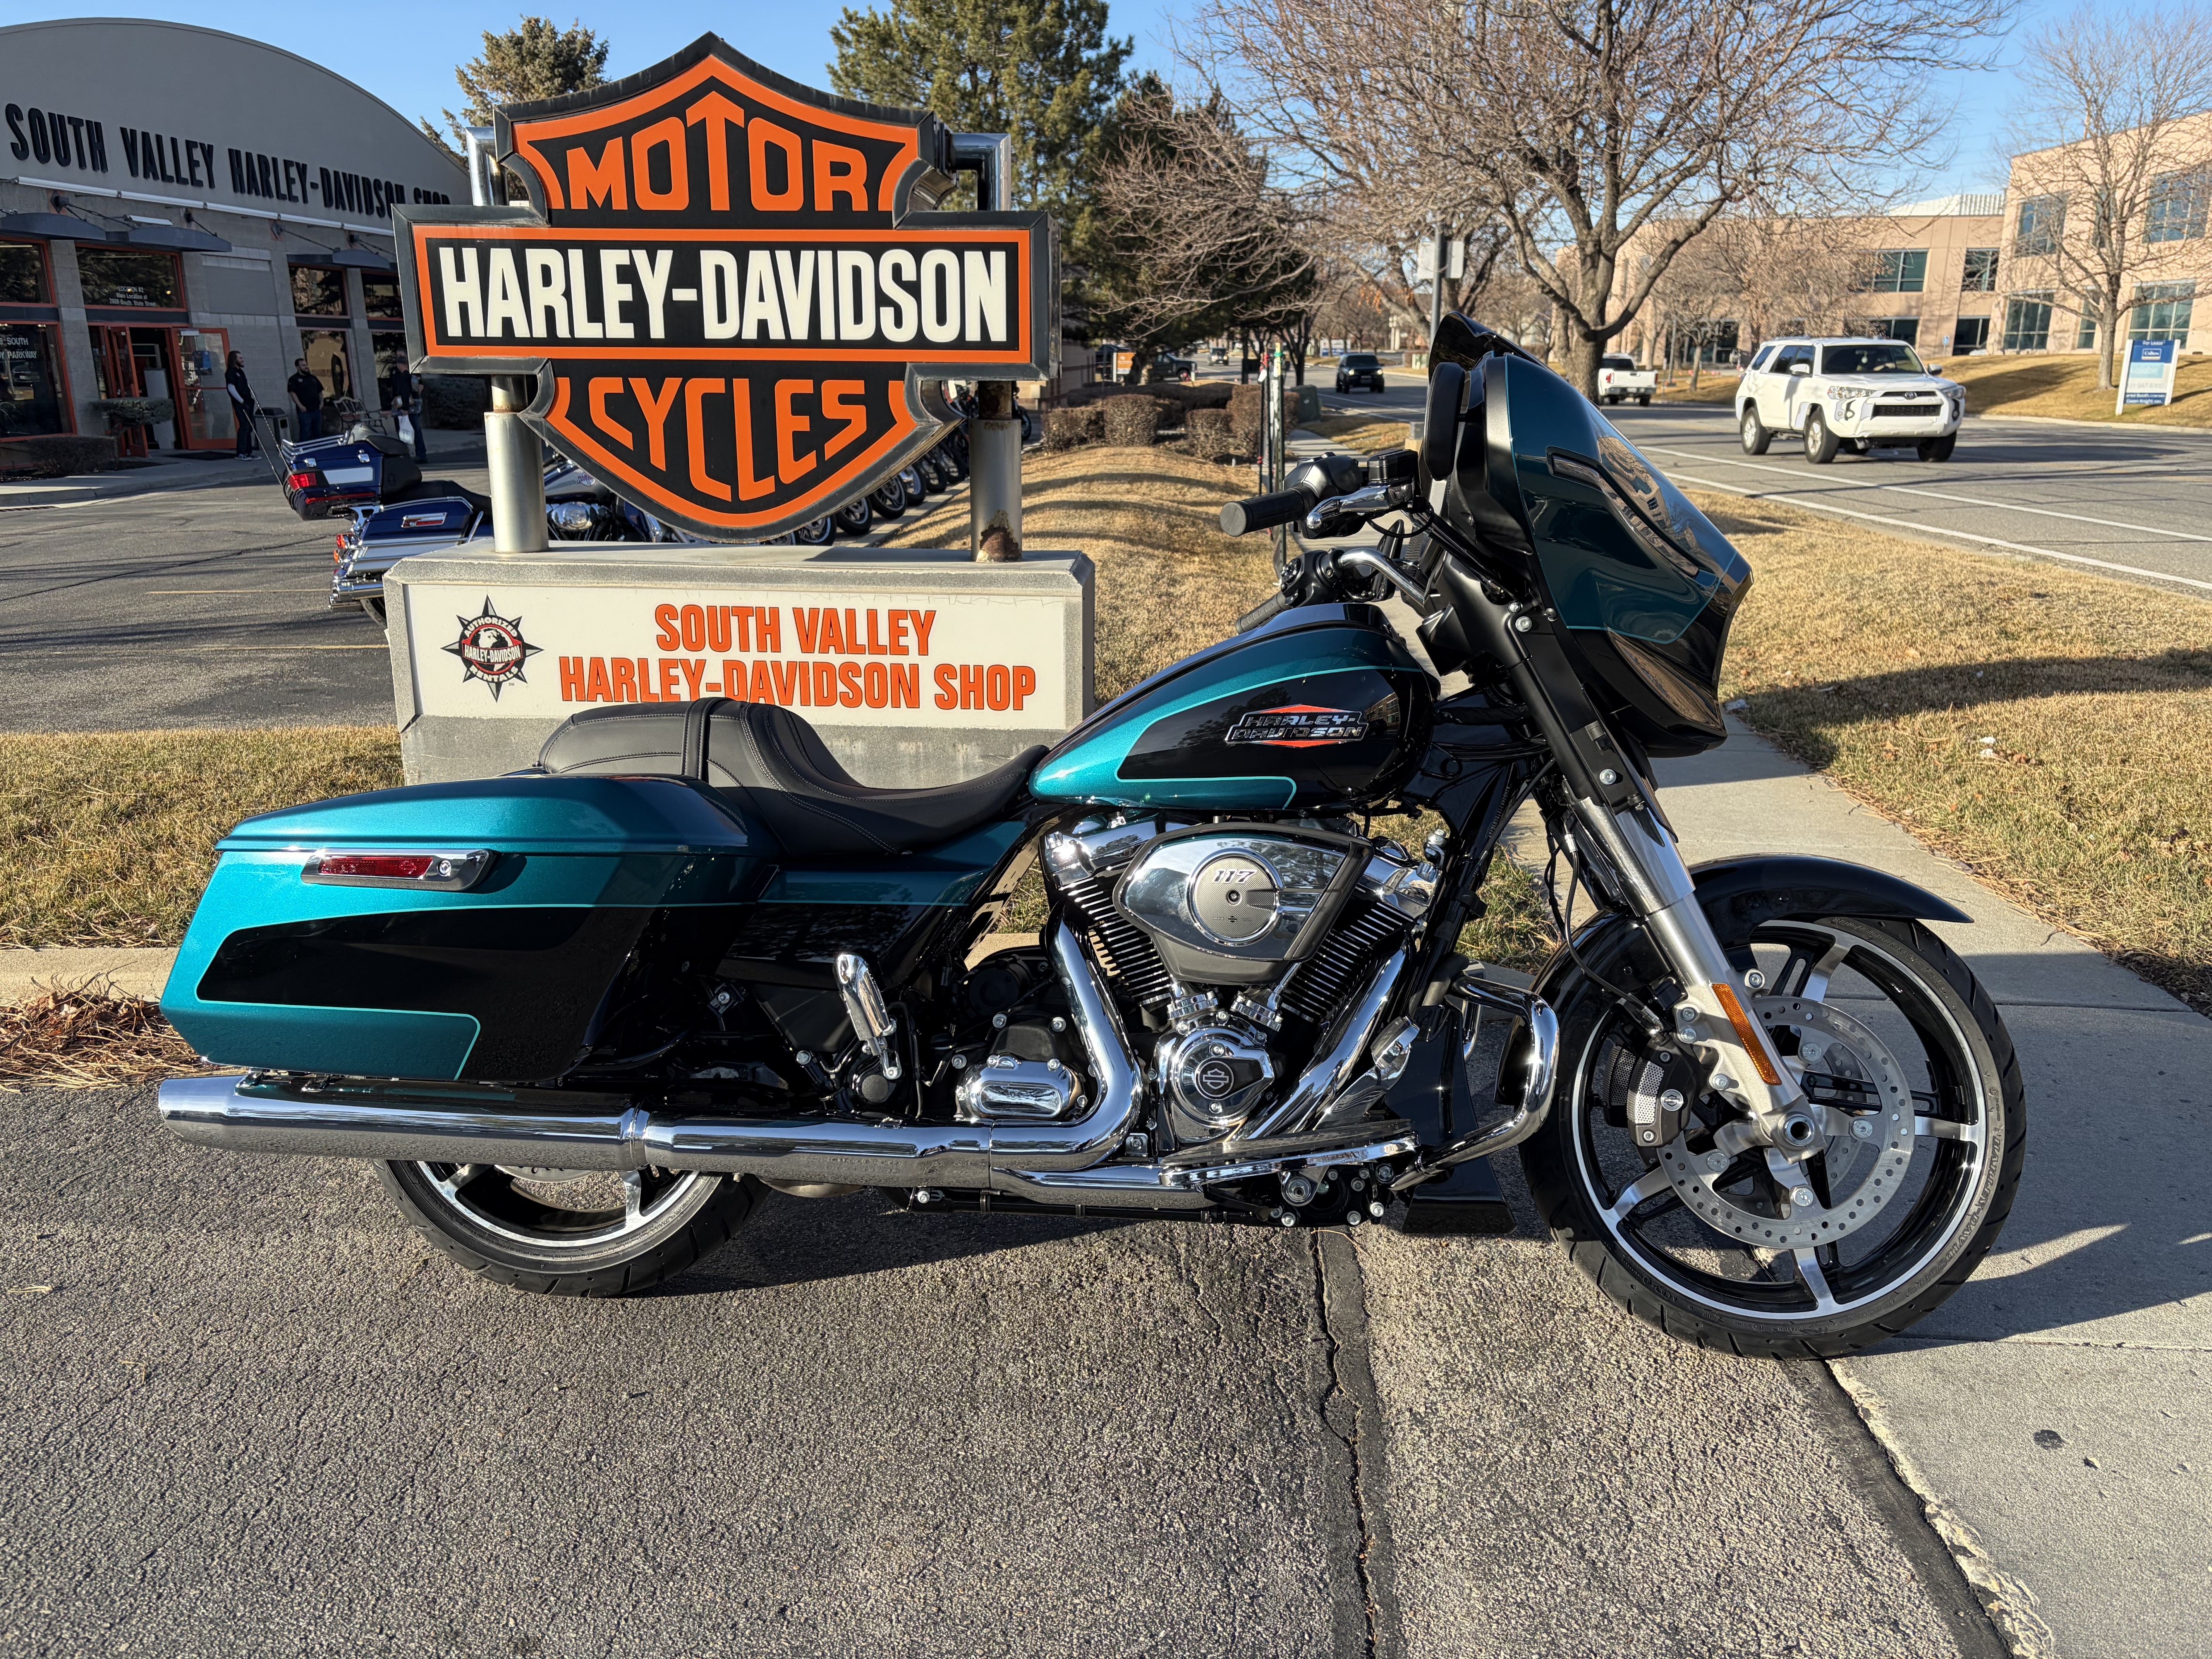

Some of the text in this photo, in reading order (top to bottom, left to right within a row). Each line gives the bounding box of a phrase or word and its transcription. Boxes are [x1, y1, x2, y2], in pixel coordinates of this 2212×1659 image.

[5, 103, 406, 220] SOUTH VALLEY HARLEY-DAVIDSON
[567, 91, 868, 211] MOTOR
[438, 247, 1007, 342] HARLEY-DAVIDSON
[7, 337, 29, 345] SOUTH
[7, 350, 37, 359] PARKWAY
[589, 377, 867, 501] CYCLES
[464, 617, 517, 638] AUTHORIZED
[656, 604, 936, 656] SOUTH VALLEY
[464, 644, 521, 663] HARLEY-DAVIDSON
[469, 665, 518, 682] RENTALS
[559, 656, 1036, 711] HARLEY-DAVIDSON SHOP
[1245, 715, 1355, 727] HARLEY-
[1231, 726, 1362, 740] DAVIDSON
[1213, 869, 1257, 884] 117
[1918, 1135, 2001, 1294] HARLEY-DAVIDSON
